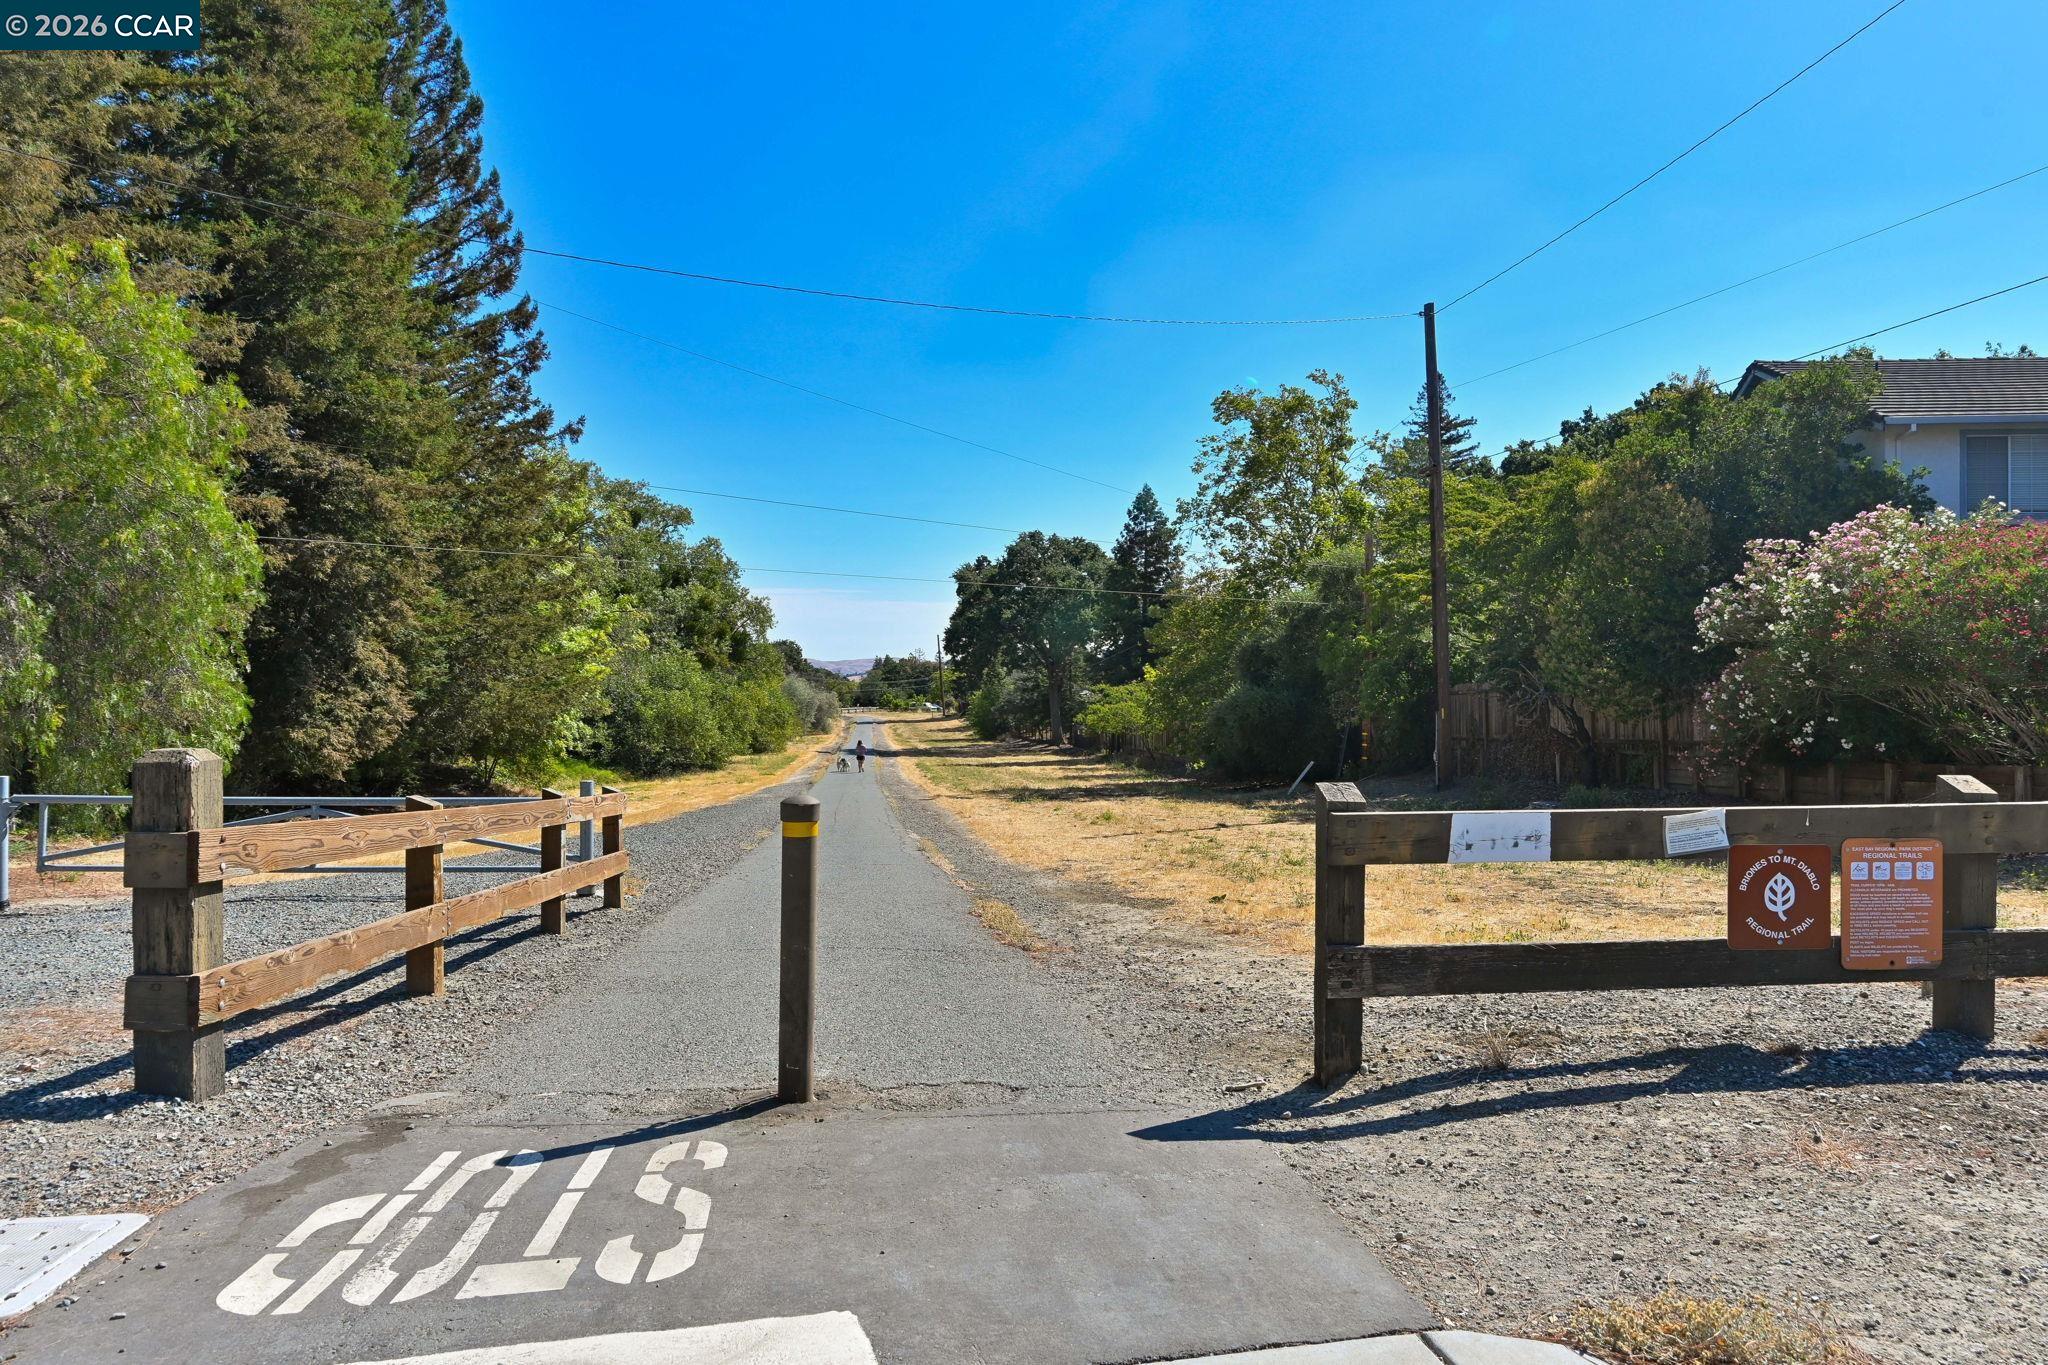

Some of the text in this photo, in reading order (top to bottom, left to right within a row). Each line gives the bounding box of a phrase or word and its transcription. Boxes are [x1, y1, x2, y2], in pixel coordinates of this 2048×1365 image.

[1739, 855, 1820, 891] BRIONES TO MT. DIABLO
[1745, 916, 1815, 939] REGIONAL TRAIL
[216, 1140, 728, 1316] STOP
